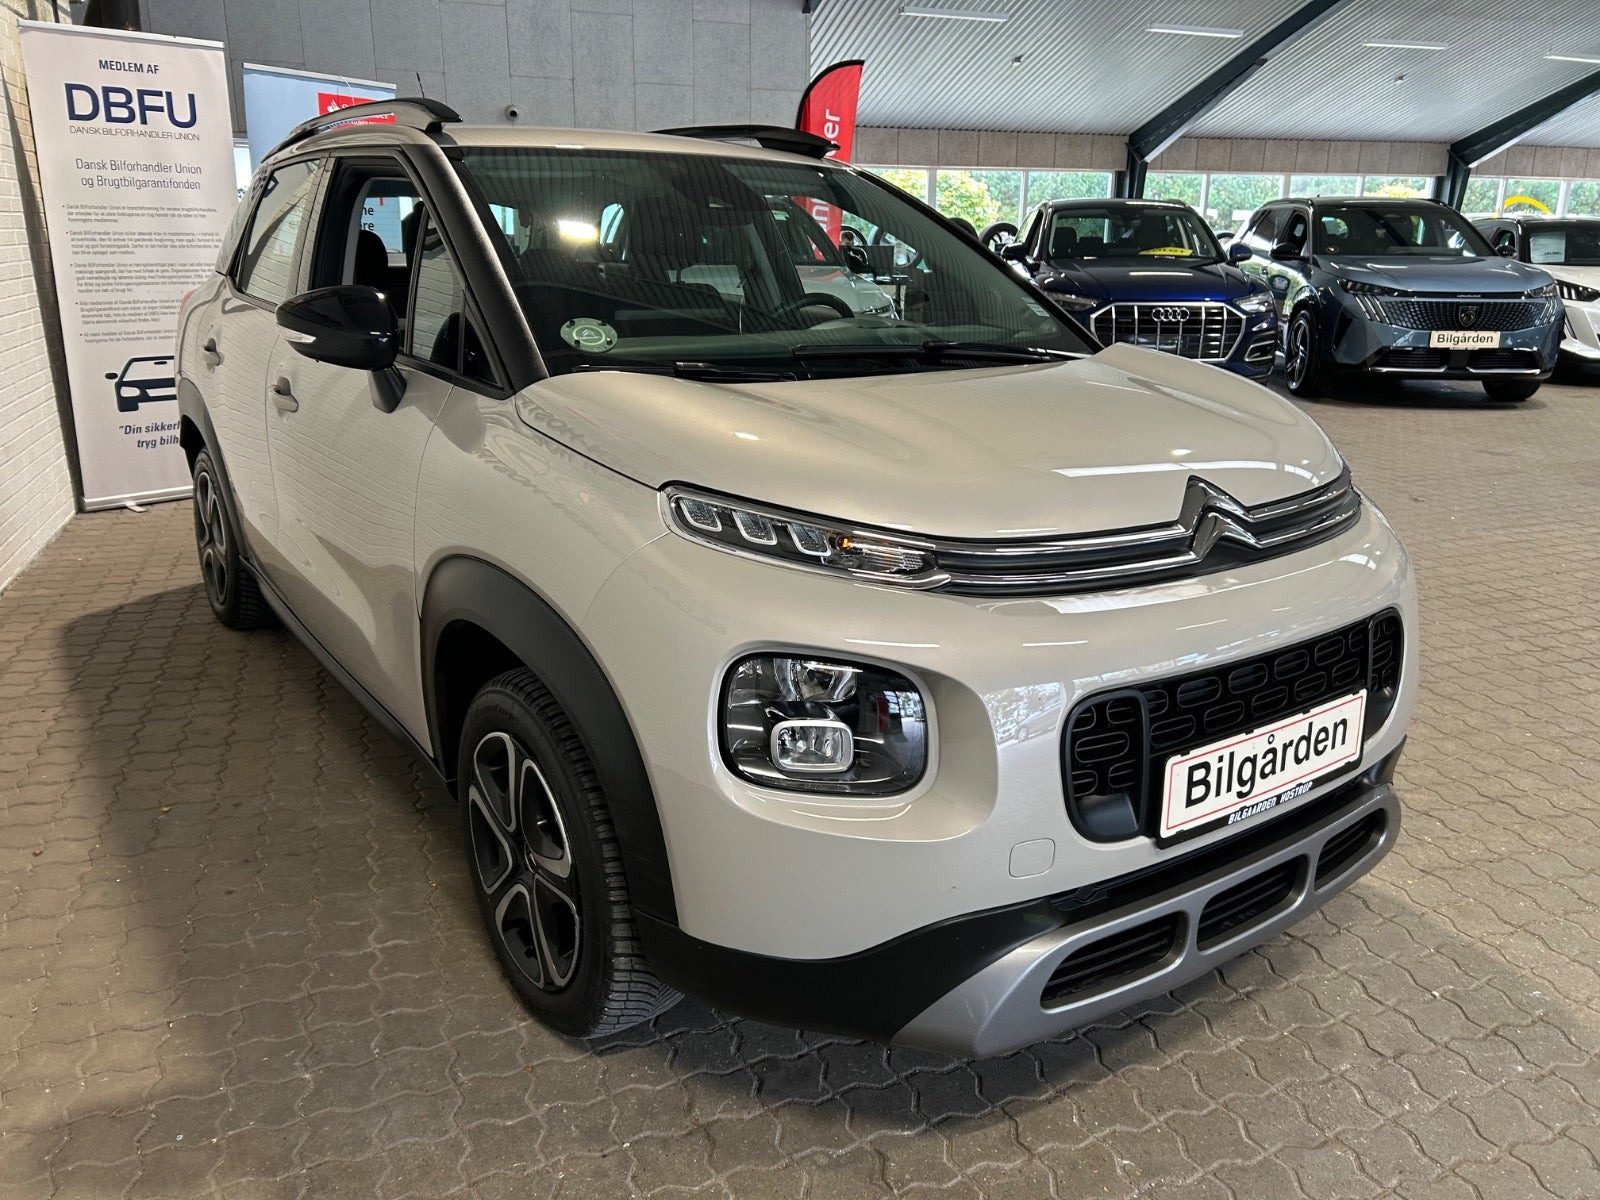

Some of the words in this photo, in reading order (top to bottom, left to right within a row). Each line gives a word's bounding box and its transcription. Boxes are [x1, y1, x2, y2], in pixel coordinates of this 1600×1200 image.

[98, 60, 144, 73] MEDLEM
[146, 64, 159, 74] AF
[64, 83, 197, 128] DBFU
[69, 125, 101, 135] DANSK
[102, 128, 173, 139] BILFORHANDLER
[174, 132, 200, 141] UNION
[75, 158, 107, 170] Dansk
[110, 159, 172, 173] Bilforhandler
[175, 163, 202, 175] Union
[81, 177, 94, 188] og
[97, 175, 201, 190] Brugtbilgarantifonden
[1437, 333, 1494, 346] Bilgården
[137, 439, 157, 449] tryg
[1185, 717, 1348, 809] Bilgården
[1228, 797, 1277, 825] BILGAARDEN
